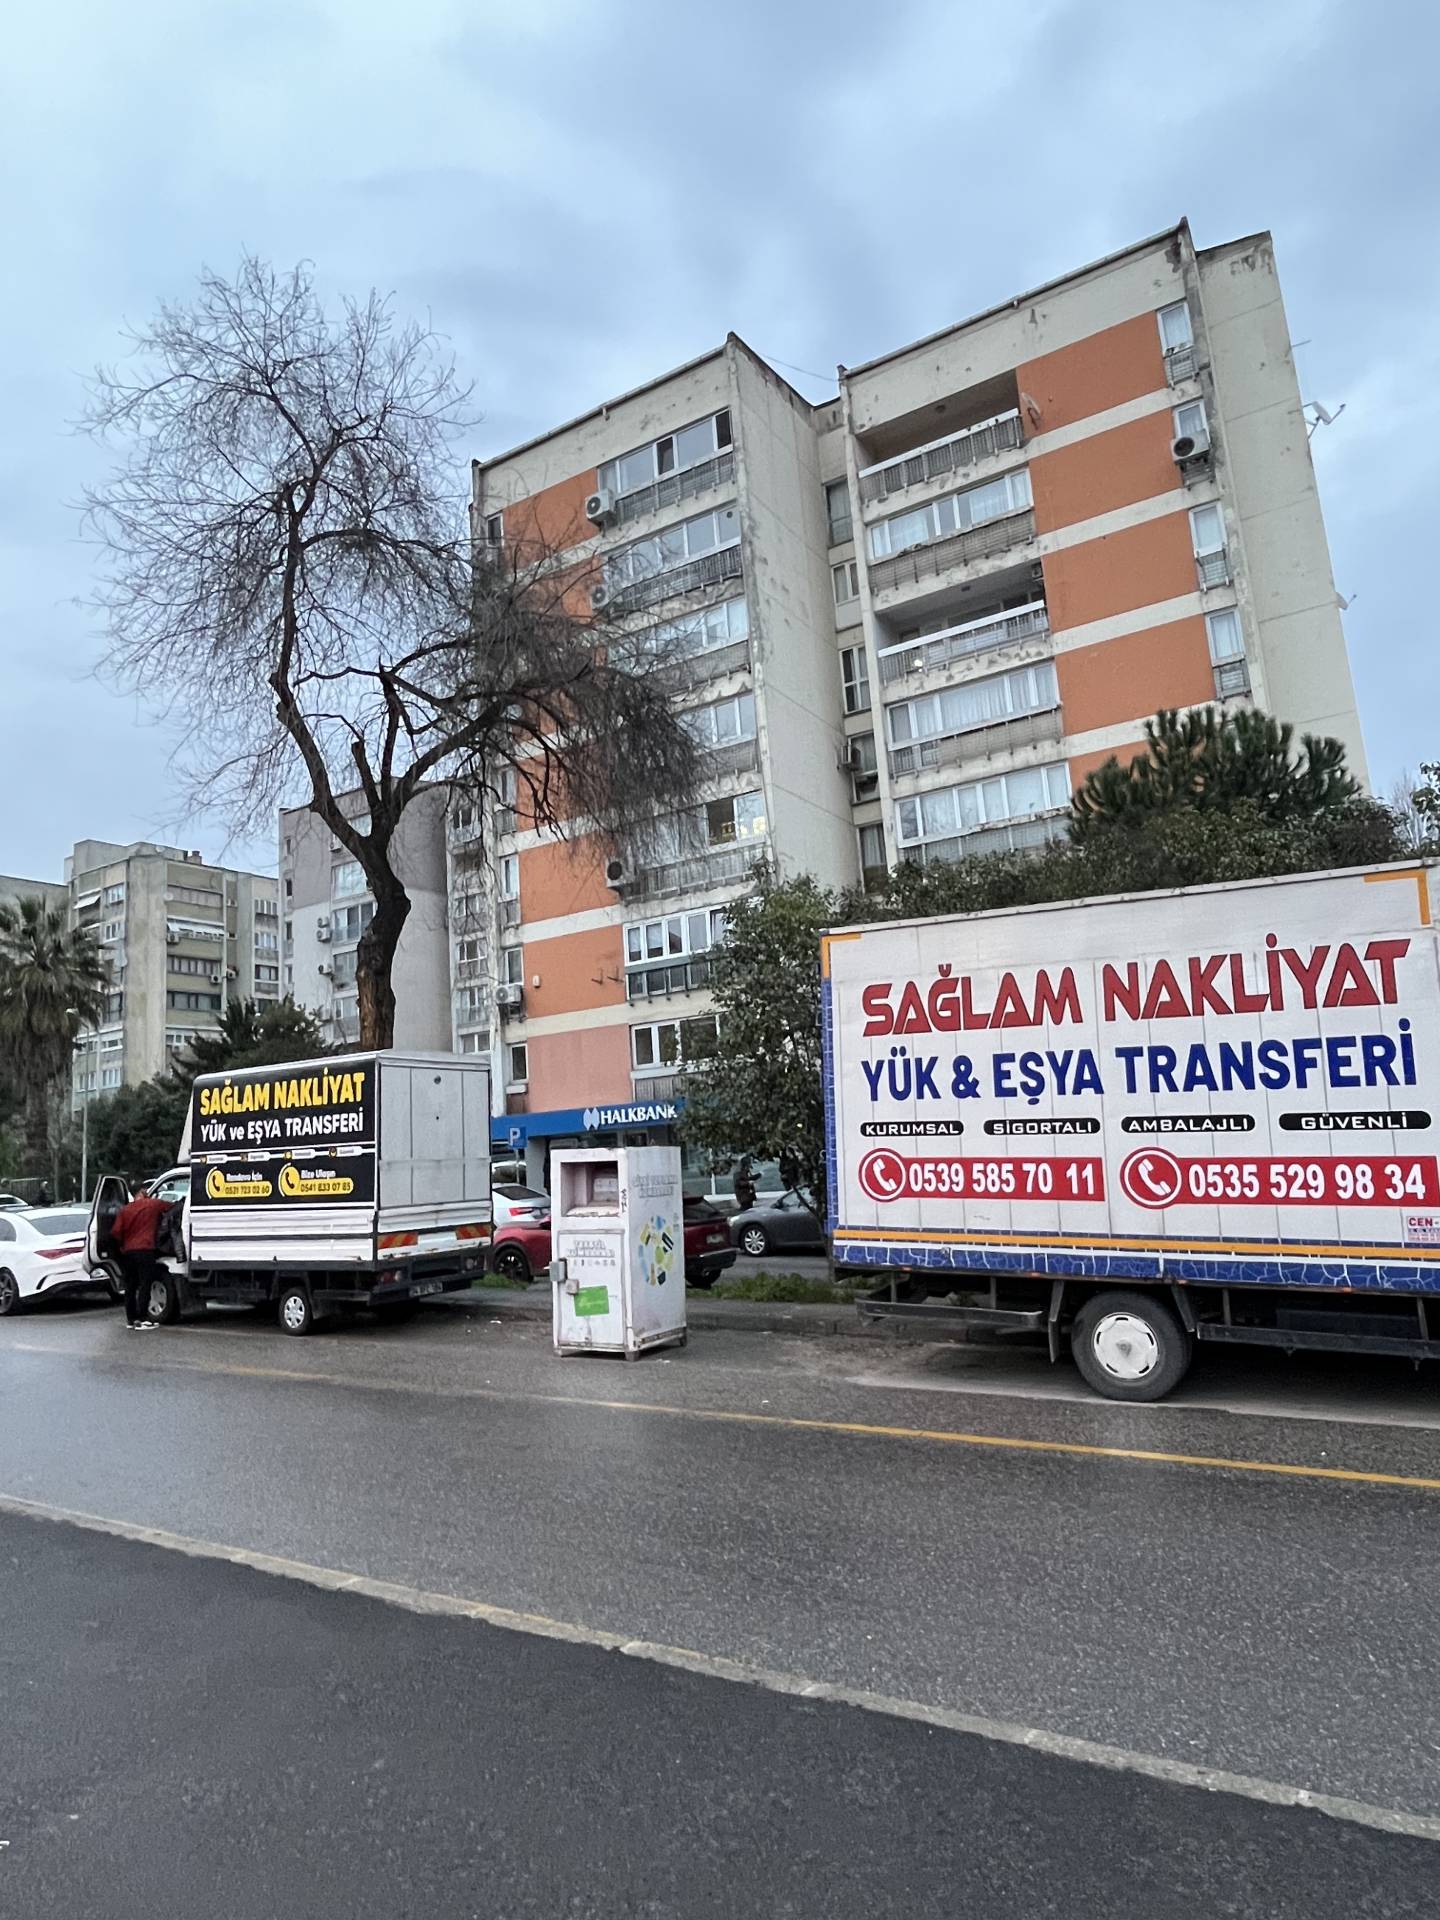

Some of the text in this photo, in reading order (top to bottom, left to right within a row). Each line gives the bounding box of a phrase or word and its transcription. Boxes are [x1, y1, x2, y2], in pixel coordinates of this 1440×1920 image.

[861, 932, 1411, 1038] SAĞLAM NAKLİYAT
[861, 1017, 1417, 1106] YÜK & EŞYA TRANSFERİ
[200, 1066, 365, 1116] SAĞLAM NAKLİYAT
[200, 1106, 364, 1145] YÜK ve EŞYA TRANSFERİ
[600, 1103, 678, 1126] HALKBANK
[993, 1119, 1093, 1135] SİGORTALI
[1128, 1117, 1249, 1132] AMBALAJLI
[1300, 1112, 1409, 1130] GÜVENLİ
[509, 1126, 521, 1147] P
[865, 1123, 959, 1136] KURUMSAL
[908, 1162, 1095, 1195] 0539 585 70 11
[1188, 1163, 1426, 1200] 0535 529 98 34
